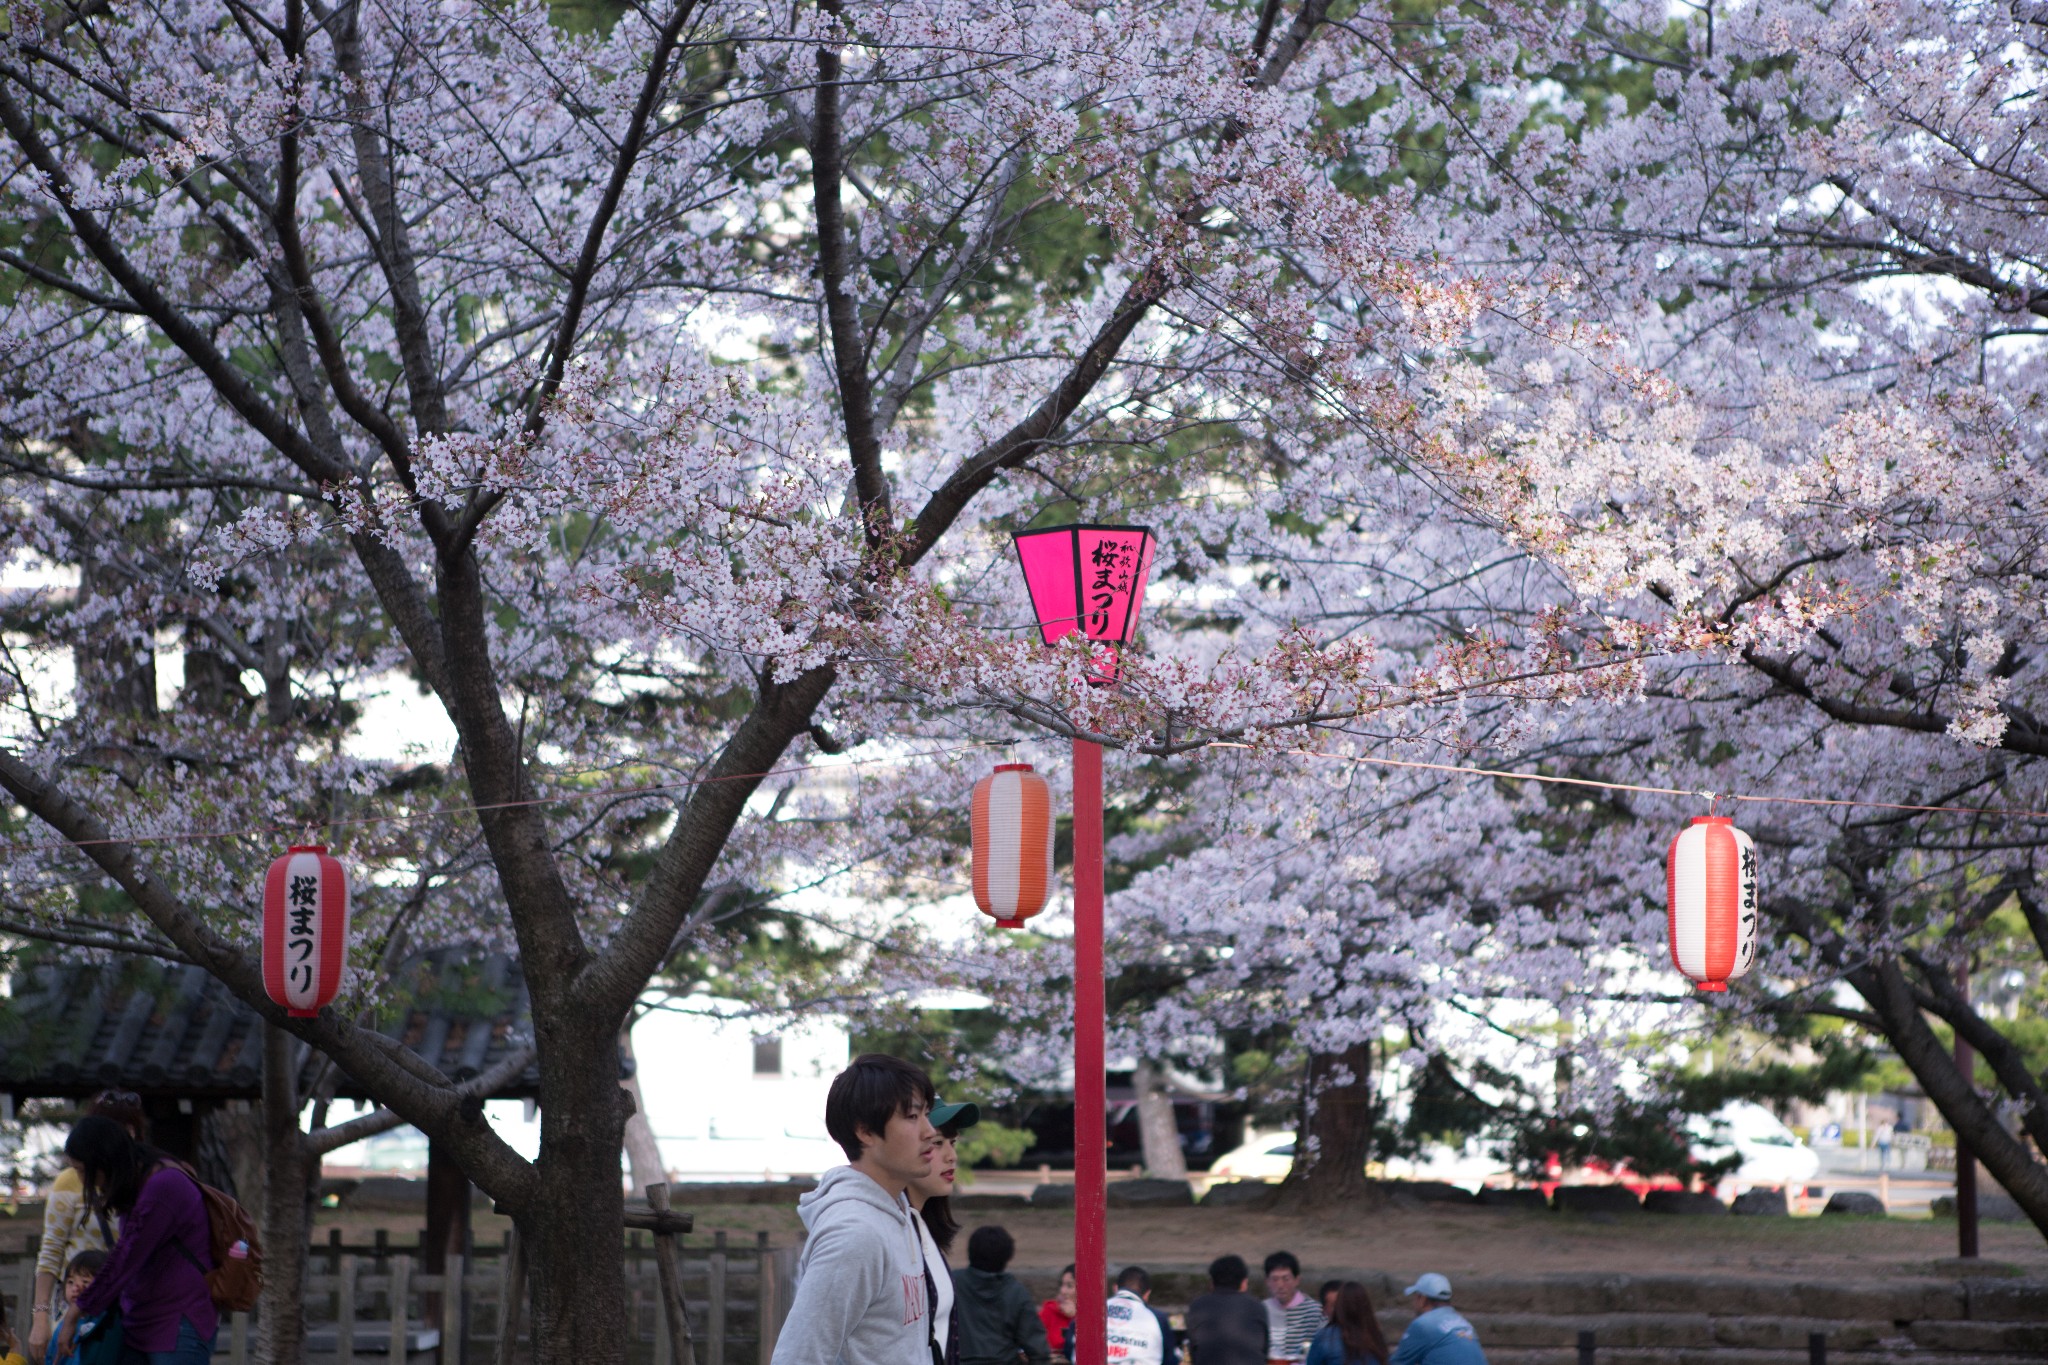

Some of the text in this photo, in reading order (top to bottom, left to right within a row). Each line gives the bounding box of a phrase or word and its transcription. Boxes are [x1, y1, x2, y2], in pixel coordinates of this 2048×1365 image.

[1091, 539, 1120, 636] 桜まつり
[288, 875, 319, 994] 桜まつり
[1741, 845, 1757, 969] 桜まつり
